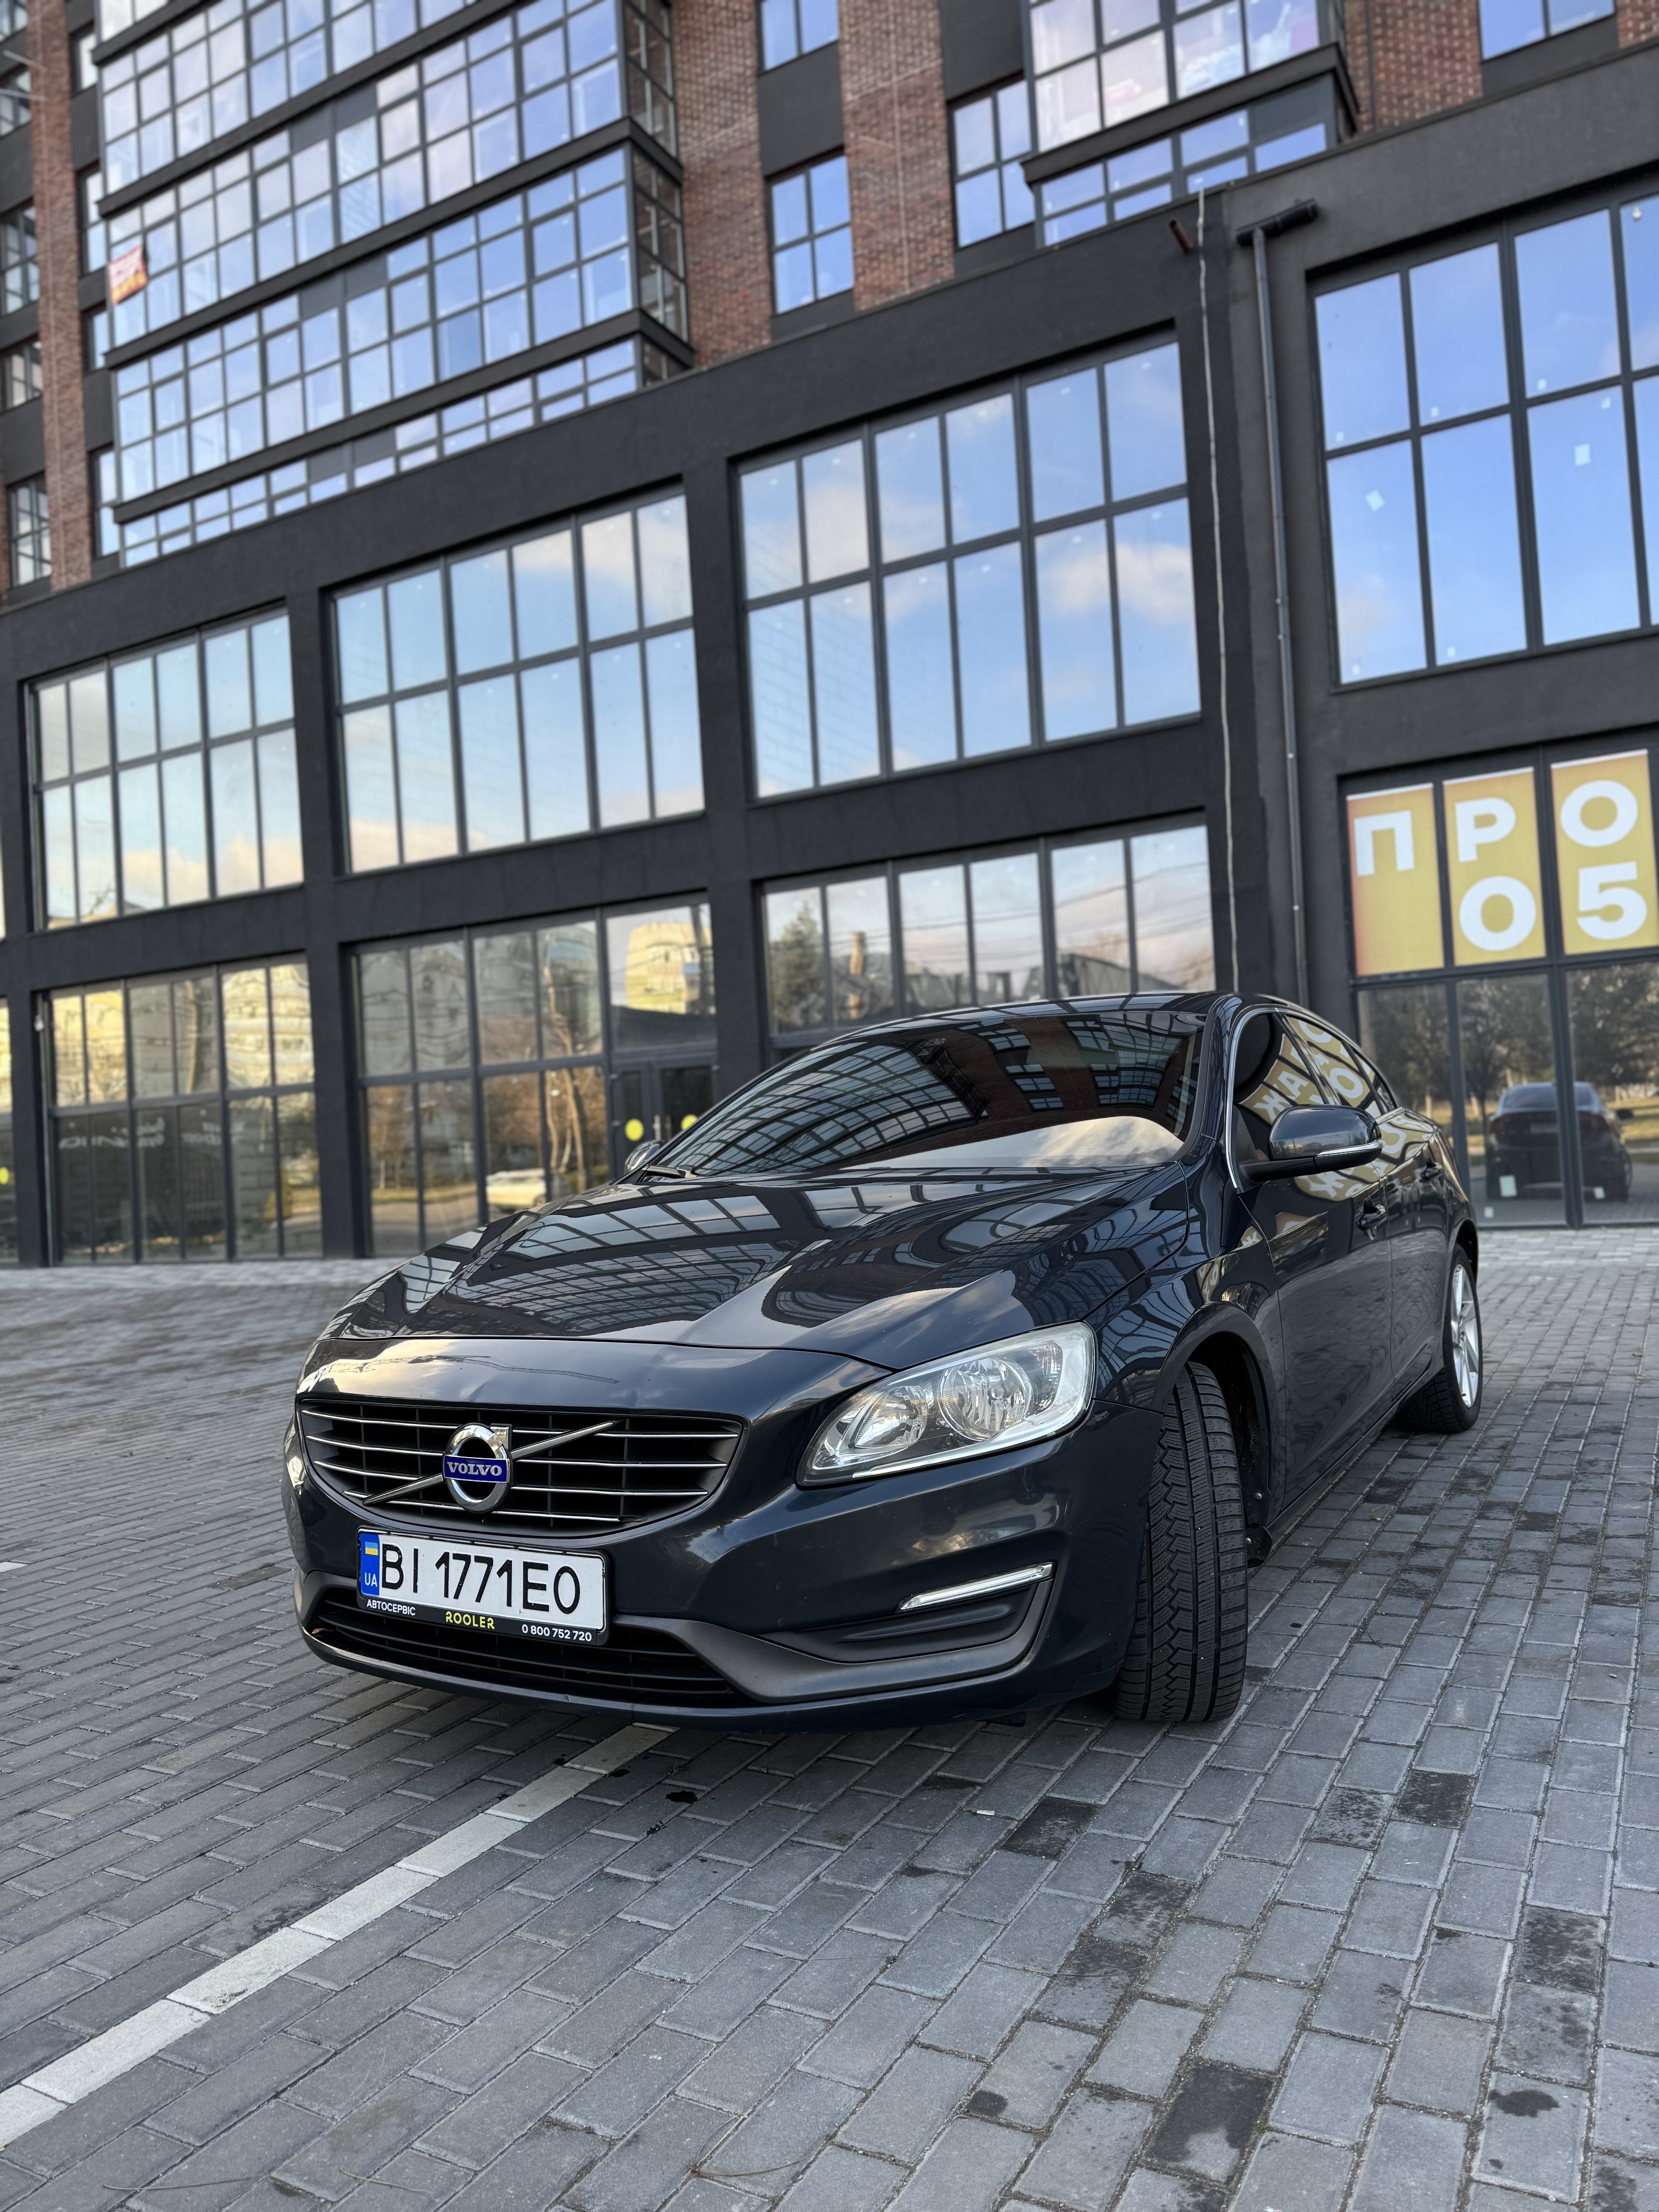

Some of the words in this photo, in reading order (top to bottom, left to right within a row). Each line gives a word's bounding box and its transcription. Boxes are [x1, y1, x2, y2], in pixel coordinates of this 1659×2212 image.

[447, 1462, 502, 1476] VOLVO
[364, 1572, 378, 1587] UA
[366, 1599, 416, 1616] АВТОСЕРВІС
[446, 1611, 495, 1629] ROOLER
